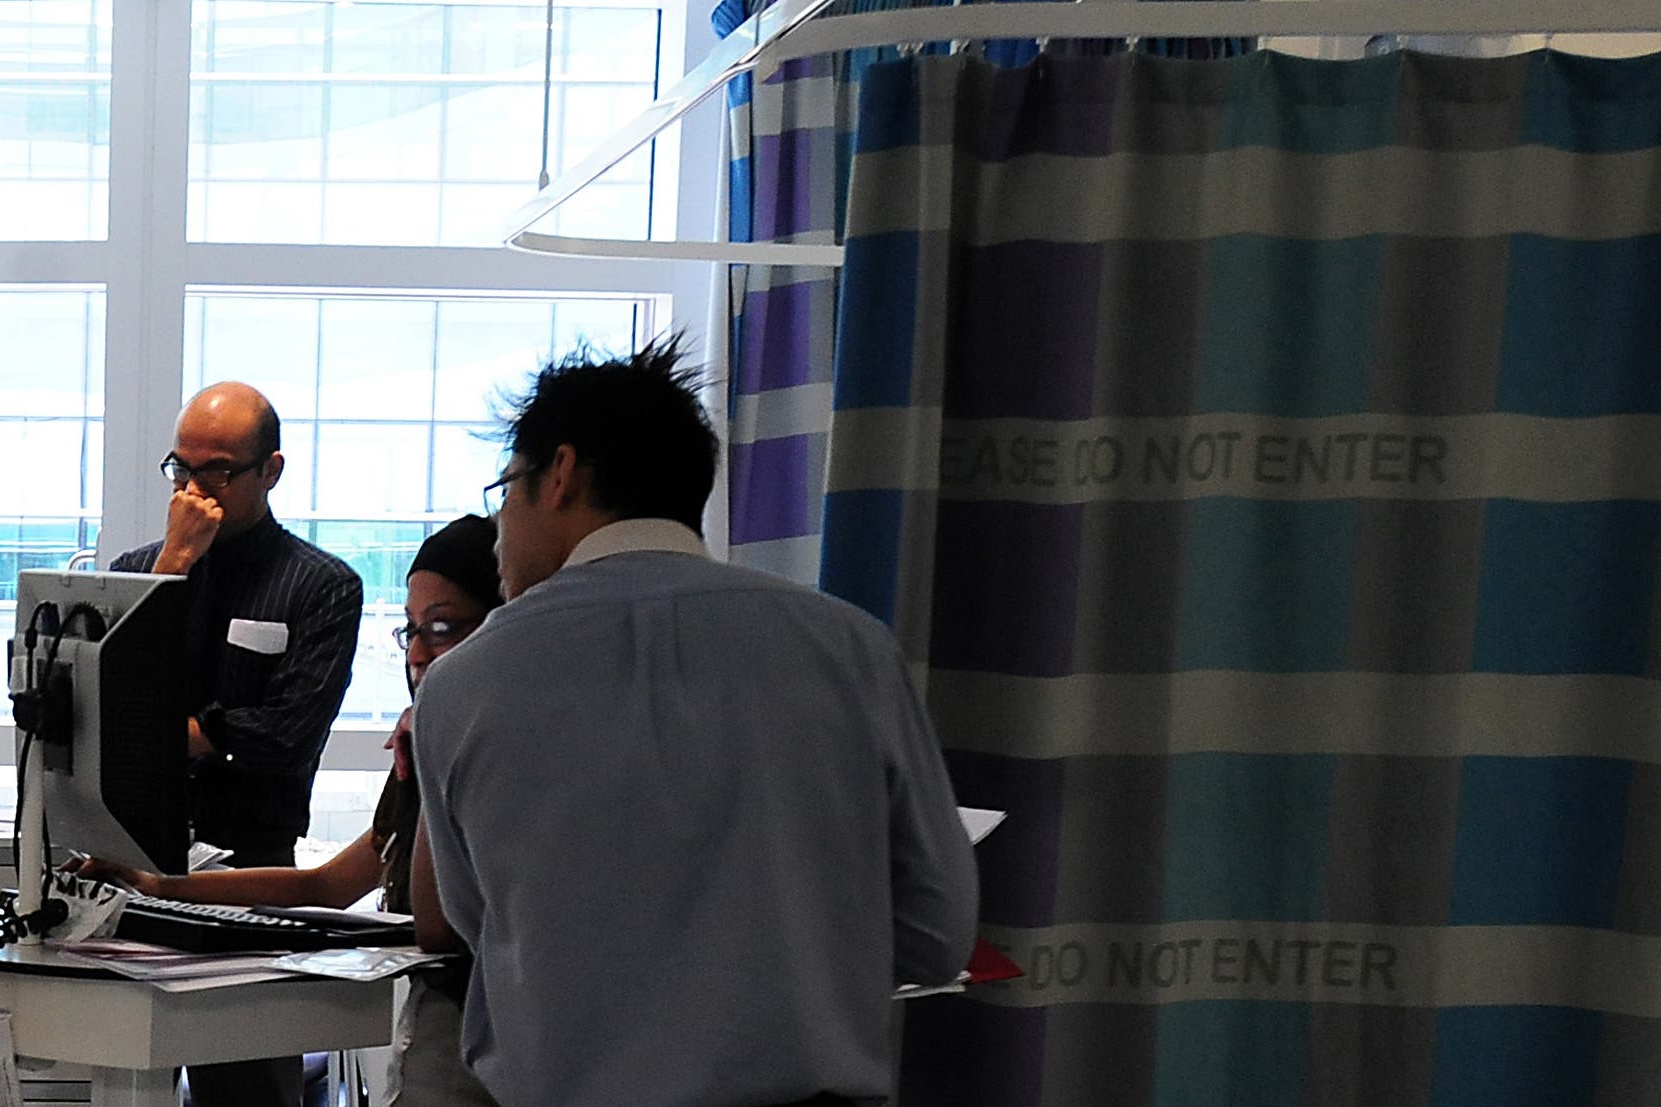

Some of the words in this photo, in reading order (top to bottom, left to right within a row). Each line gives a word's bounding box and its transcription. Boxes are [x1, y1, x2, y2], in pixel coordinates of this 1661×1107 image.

[1074, 434, 1124, 485] DO
[1143, 431, 1241, 484] NOT
[1254, 433, 1448, 484] ENTER
[1030, 940, 1089, 991] DO
[1109, 938, 1202, 988] NOT
[1212, 937, 1398, 990] ENTER
